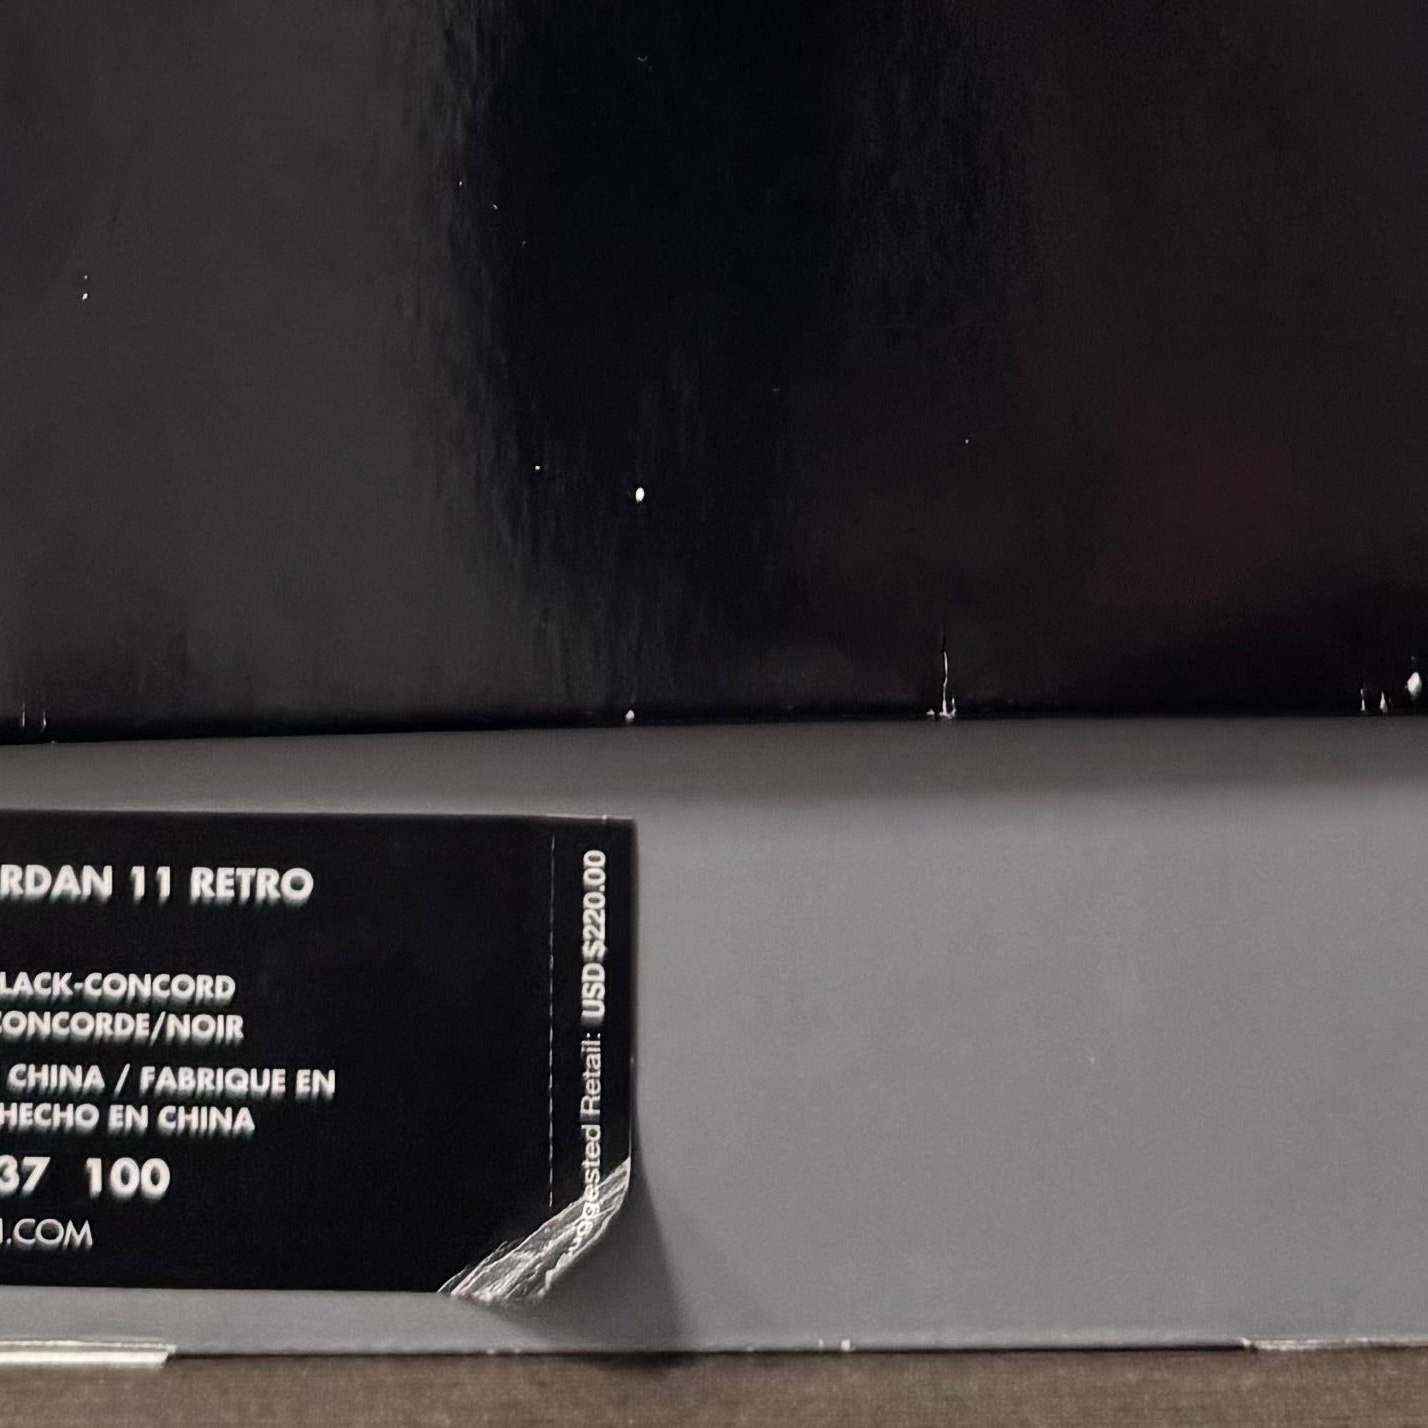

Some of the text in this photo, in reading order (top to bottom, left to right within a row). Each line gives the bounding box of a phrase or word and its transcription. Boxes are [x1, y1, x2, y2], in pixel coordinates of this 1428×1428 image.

[130, 865, 171, 901] 11
[190, 866, 314, 903] RETRO
[581, 849, 607, 960] $220.00
[581, 962, 606, 1021] USD
[7, 1063, 106, 1093] CHINA
[139, 1065, 286, 1096] FABRIQUE
[295, 1068, 336, 1098] EN
[579, 1032, 602, 1117] Retail:
[108, 1104, 149, 1132] EN
[157, 1105, 256, 1134] CHINA
[86, 1157, 171, 1198] 100
